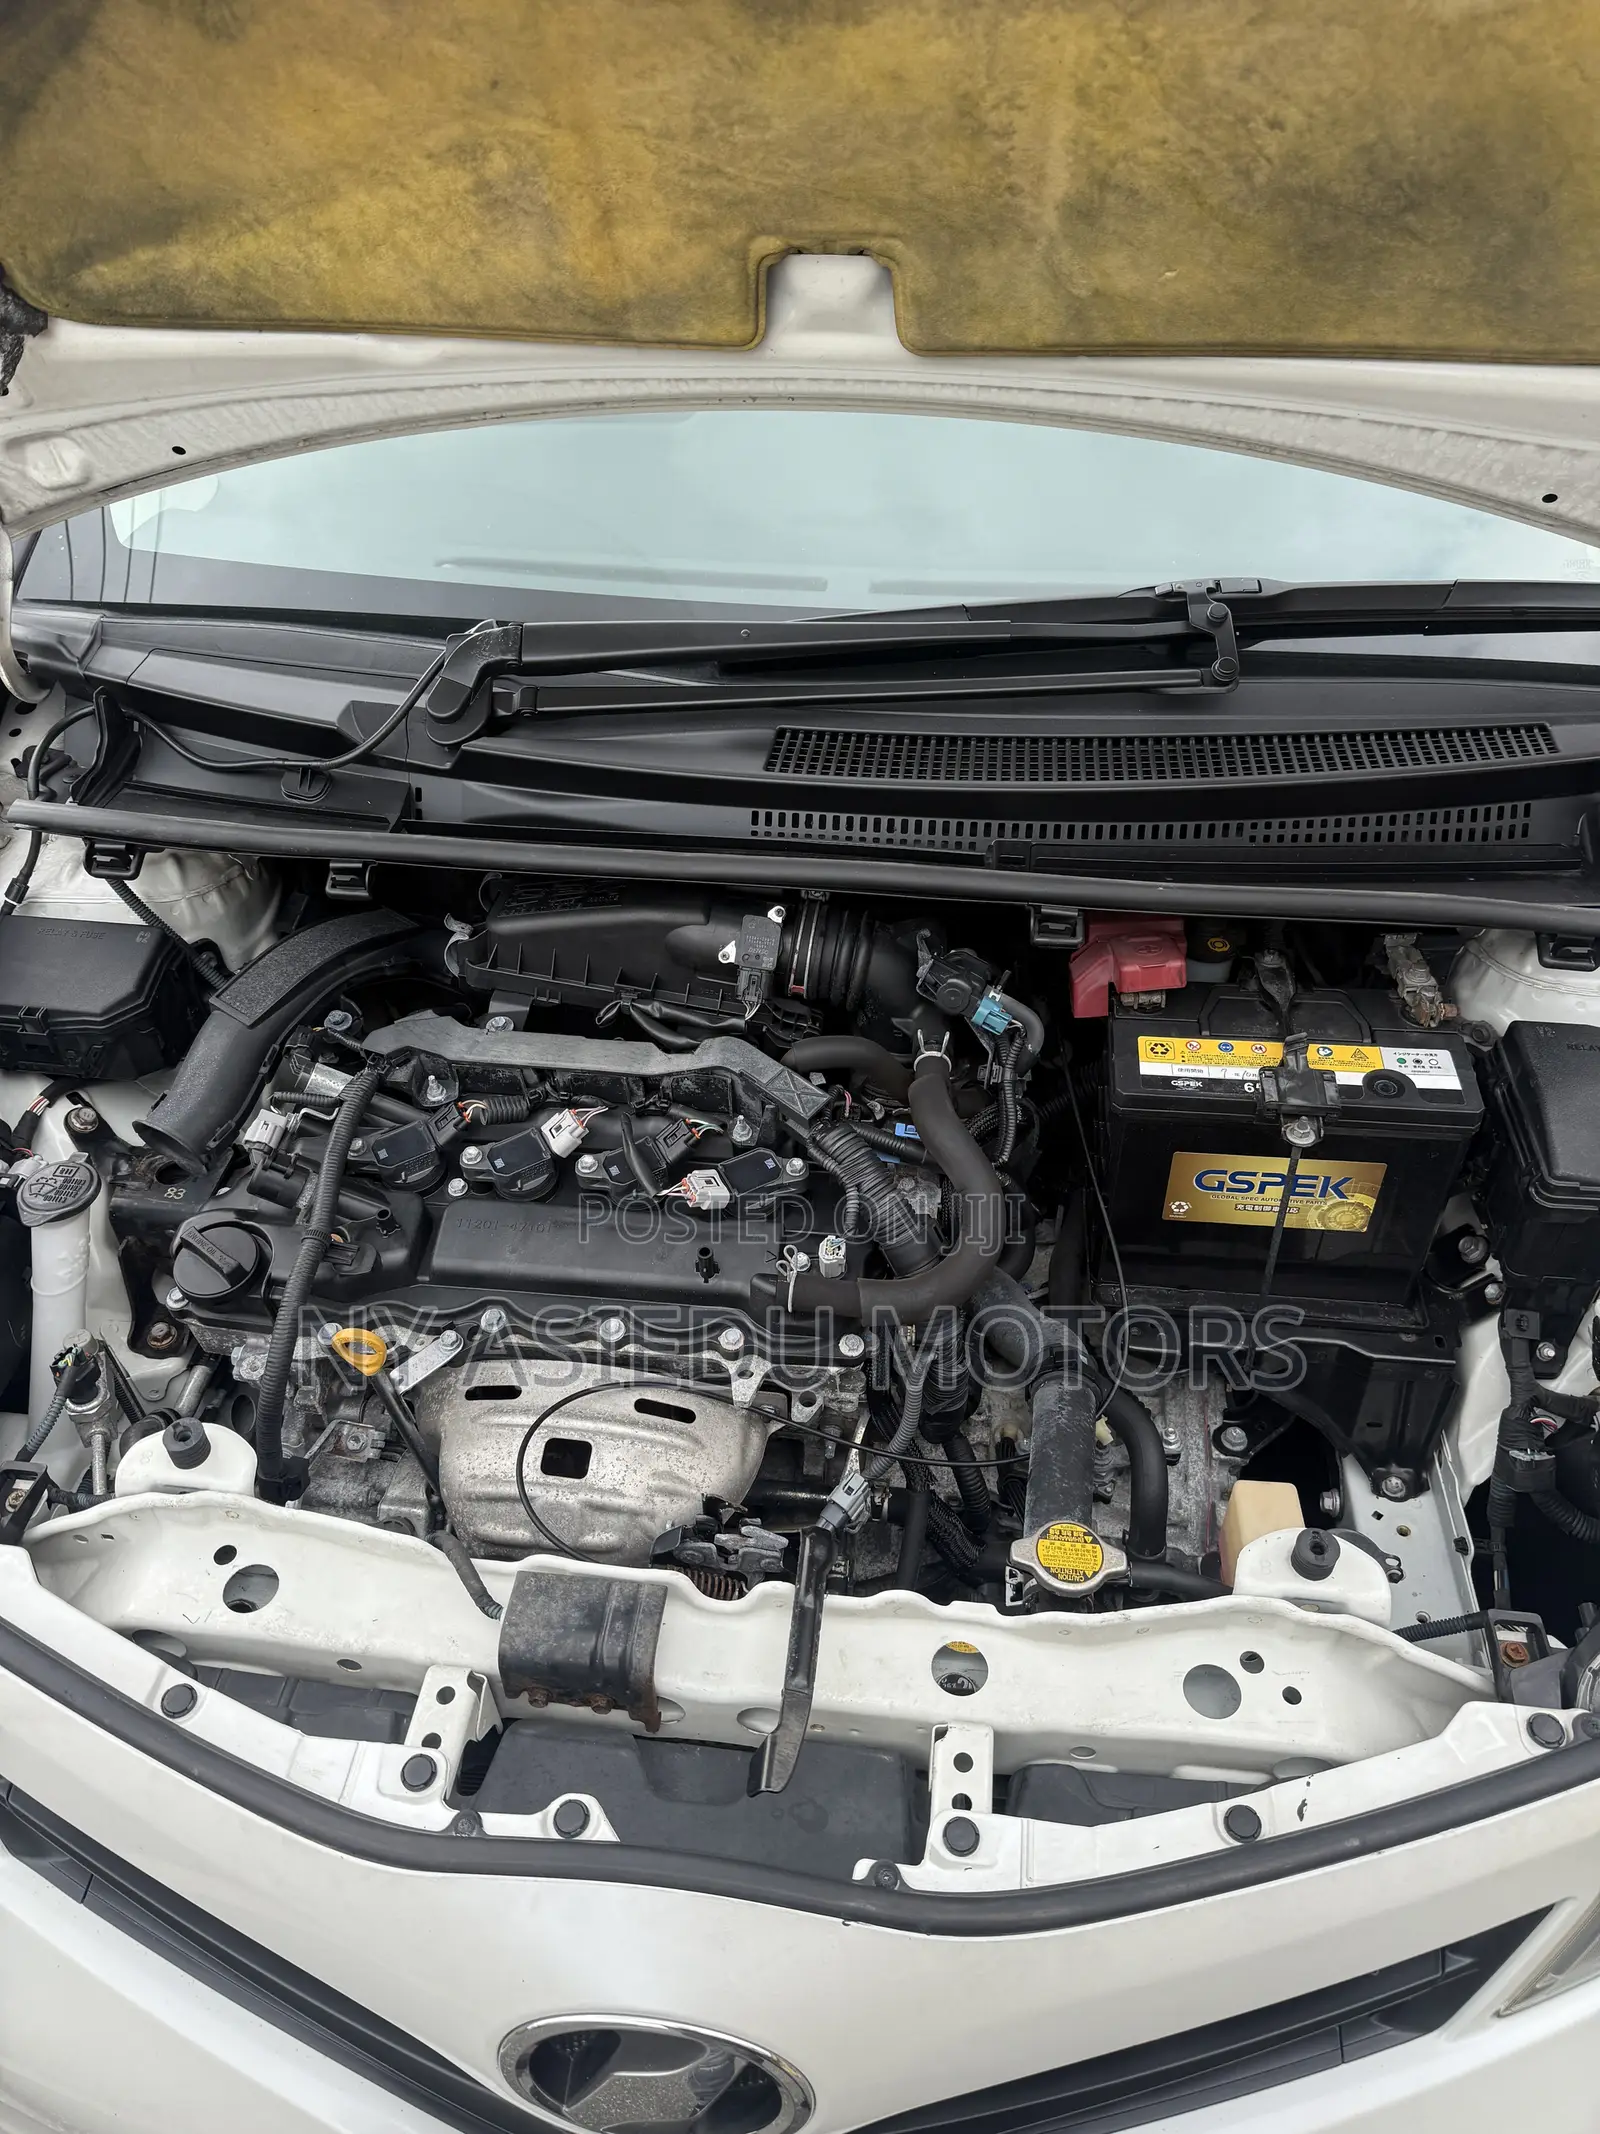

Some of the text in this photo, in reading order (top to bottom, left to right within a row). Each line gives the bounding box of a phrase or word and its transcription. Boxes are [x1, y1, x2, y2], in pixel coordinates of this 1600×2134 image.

[80, 930, 106, 940] FUSE
[1170, 1079, 1204, 1088] GSPEK
[1194, 1169, 1354, 1200] GSPEK
[163, 1186, 187, 1200] 83
[187, 1230, 217, 1256] ENGINE OIL
[1050, 1566, 1084, 1575] ATTENTION
[1057, 1573, 1085, 1582] CAUTION
